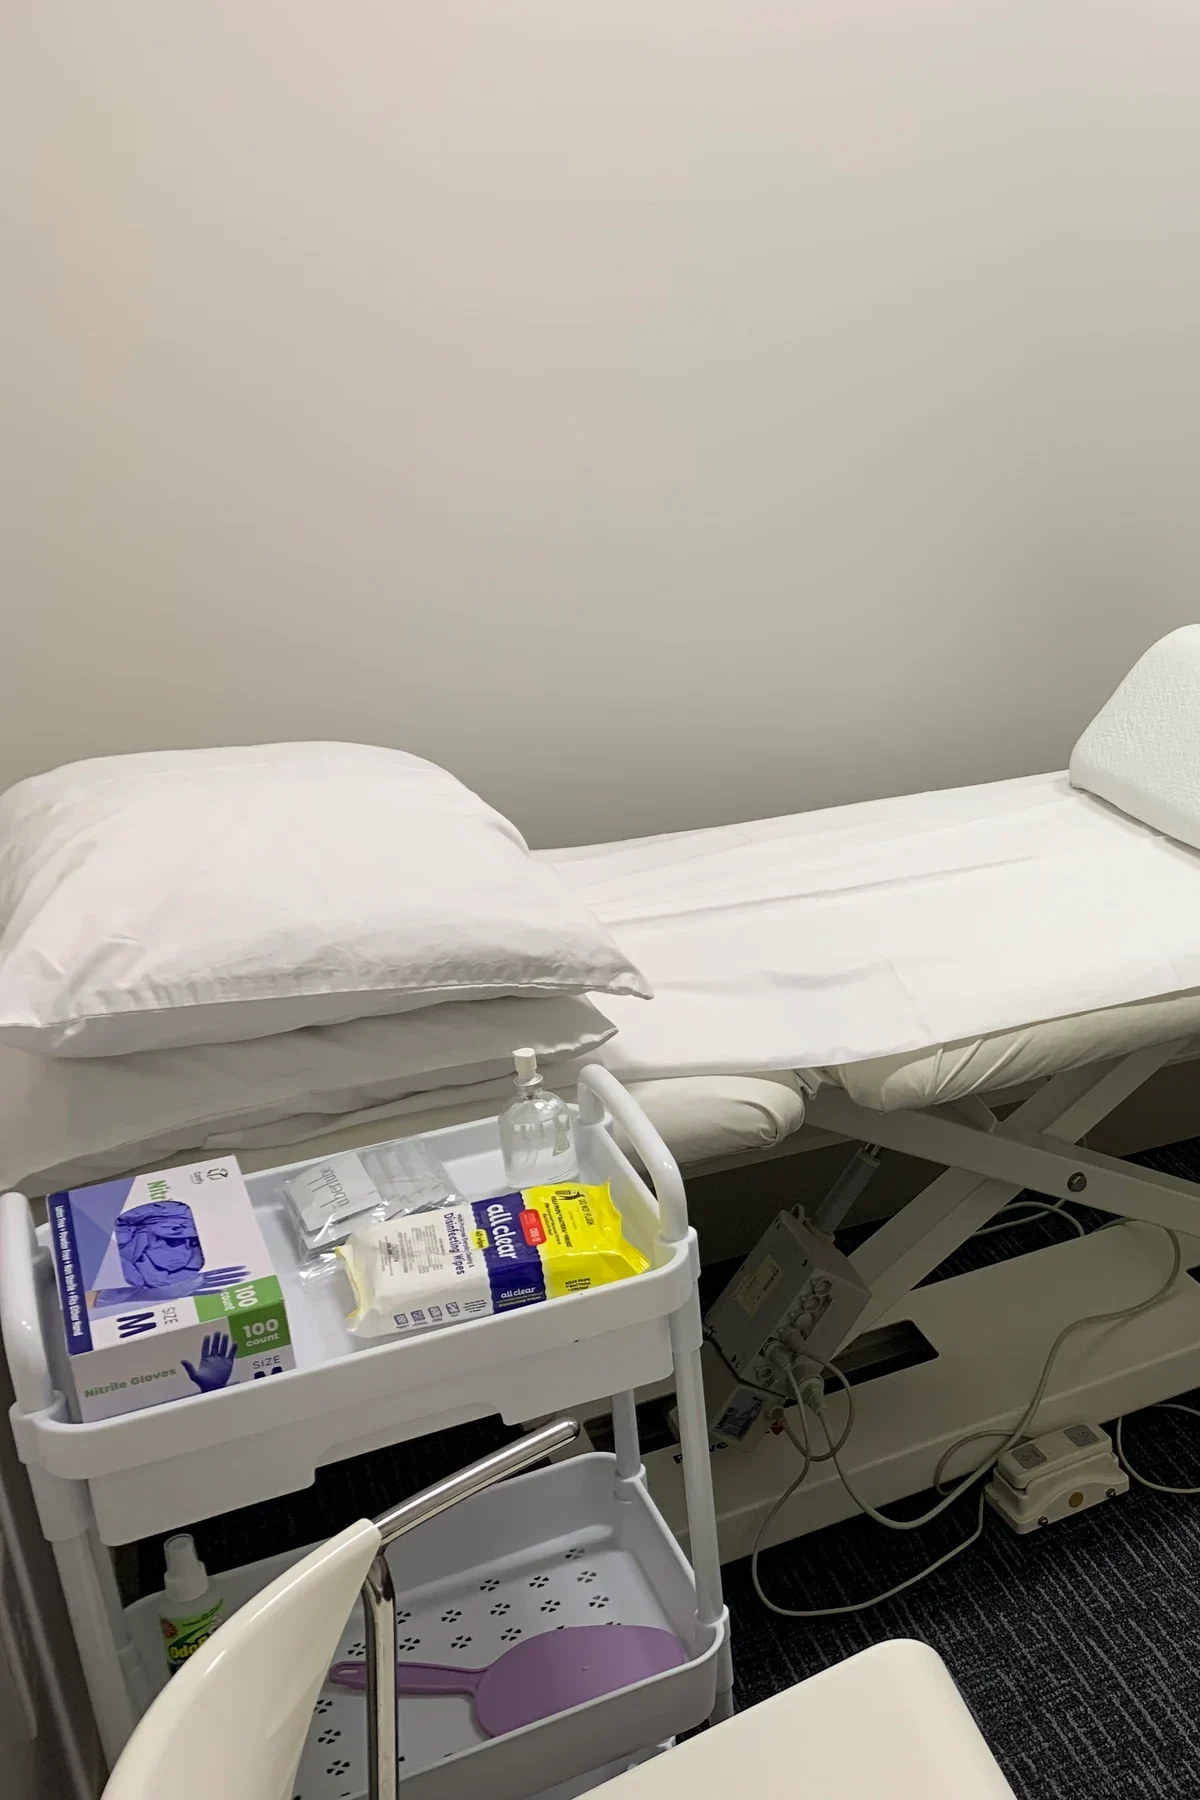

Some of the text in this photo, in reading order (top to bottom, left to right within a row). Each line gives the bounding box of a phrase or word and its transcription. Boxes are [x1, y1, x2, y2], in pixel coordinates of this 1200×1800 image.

[147, 1180, 170, 1200] Nitr
[58, 1217, 66, 1228] Free
[59, 1231, 70, 1250] Powder
[444, 1212, 466, 1275] Disinfecting Wipes
[62, 1249, 70, 1260] Free
[220, 1290, 236, 1312] count
[234, 1285, 258, 1308] 100
[116, 1311, 157, 1338] M
[162, 1307, 178, 1325] SIZE
[243, 1318, 279, 1339] 100
[246, 1332, 280, 1347] count
[252, 1355, 282, 1370] SIZE
[84, 1367, 177, 1398] Nitrile Gloves
